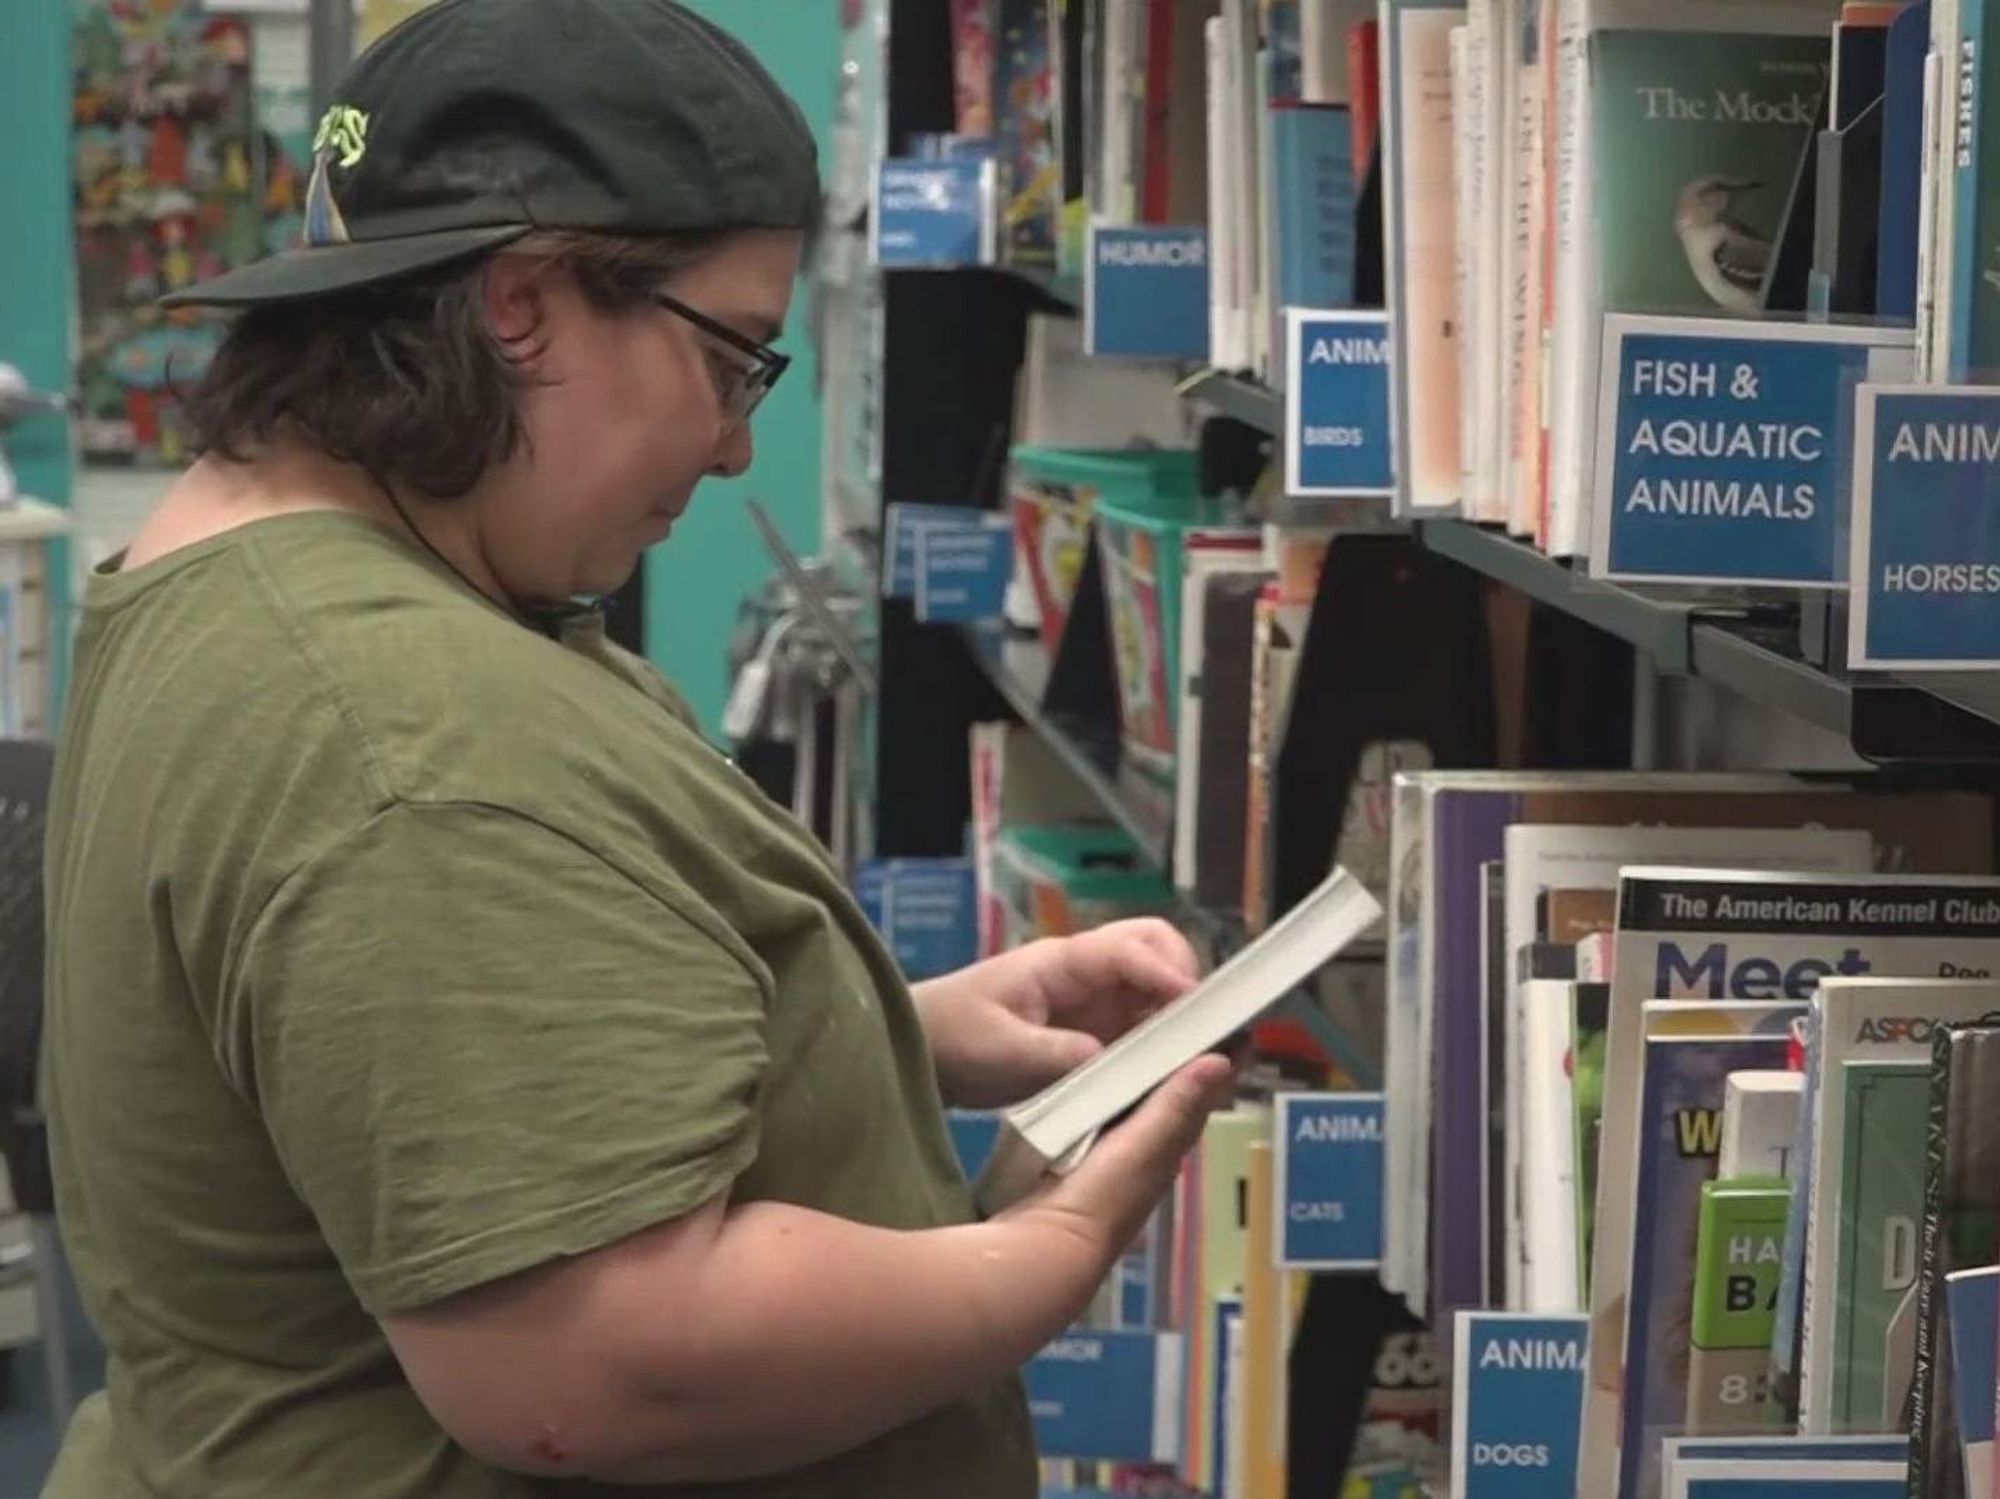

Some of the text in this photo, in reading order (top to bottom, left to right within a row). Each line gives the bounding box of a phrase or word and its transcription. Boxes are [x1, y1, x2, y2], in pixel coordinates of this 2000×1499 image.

[1639, 87, 1706, 121] The
[1959, 38, 1975, 168] FISHES
[1100, 241, 1206, 267] HUMOR
[1633, 359, 1760, 400] FISH &
[1303, 426, 1363, 447] BIRDS
[1628, 418, 1824, 462] AQUATIC
[1624, 479, 1816, 520] ANIMALS
[1883, 563, 2000, 594] HORSES
[1660, 892, 2000, 924] The American Kennel Club
[1655, 941, 1871, 1001] Meet
[1856, 1016, 1941, 1044] ASPC
[1296, 1114, 1384, 1142] ANIM
[1290, 1201, 1345, 1222] CATS
[1479, 1338, 1586, 1371] ANIM
[1472, 1442, 1550, 1468] DOGS
